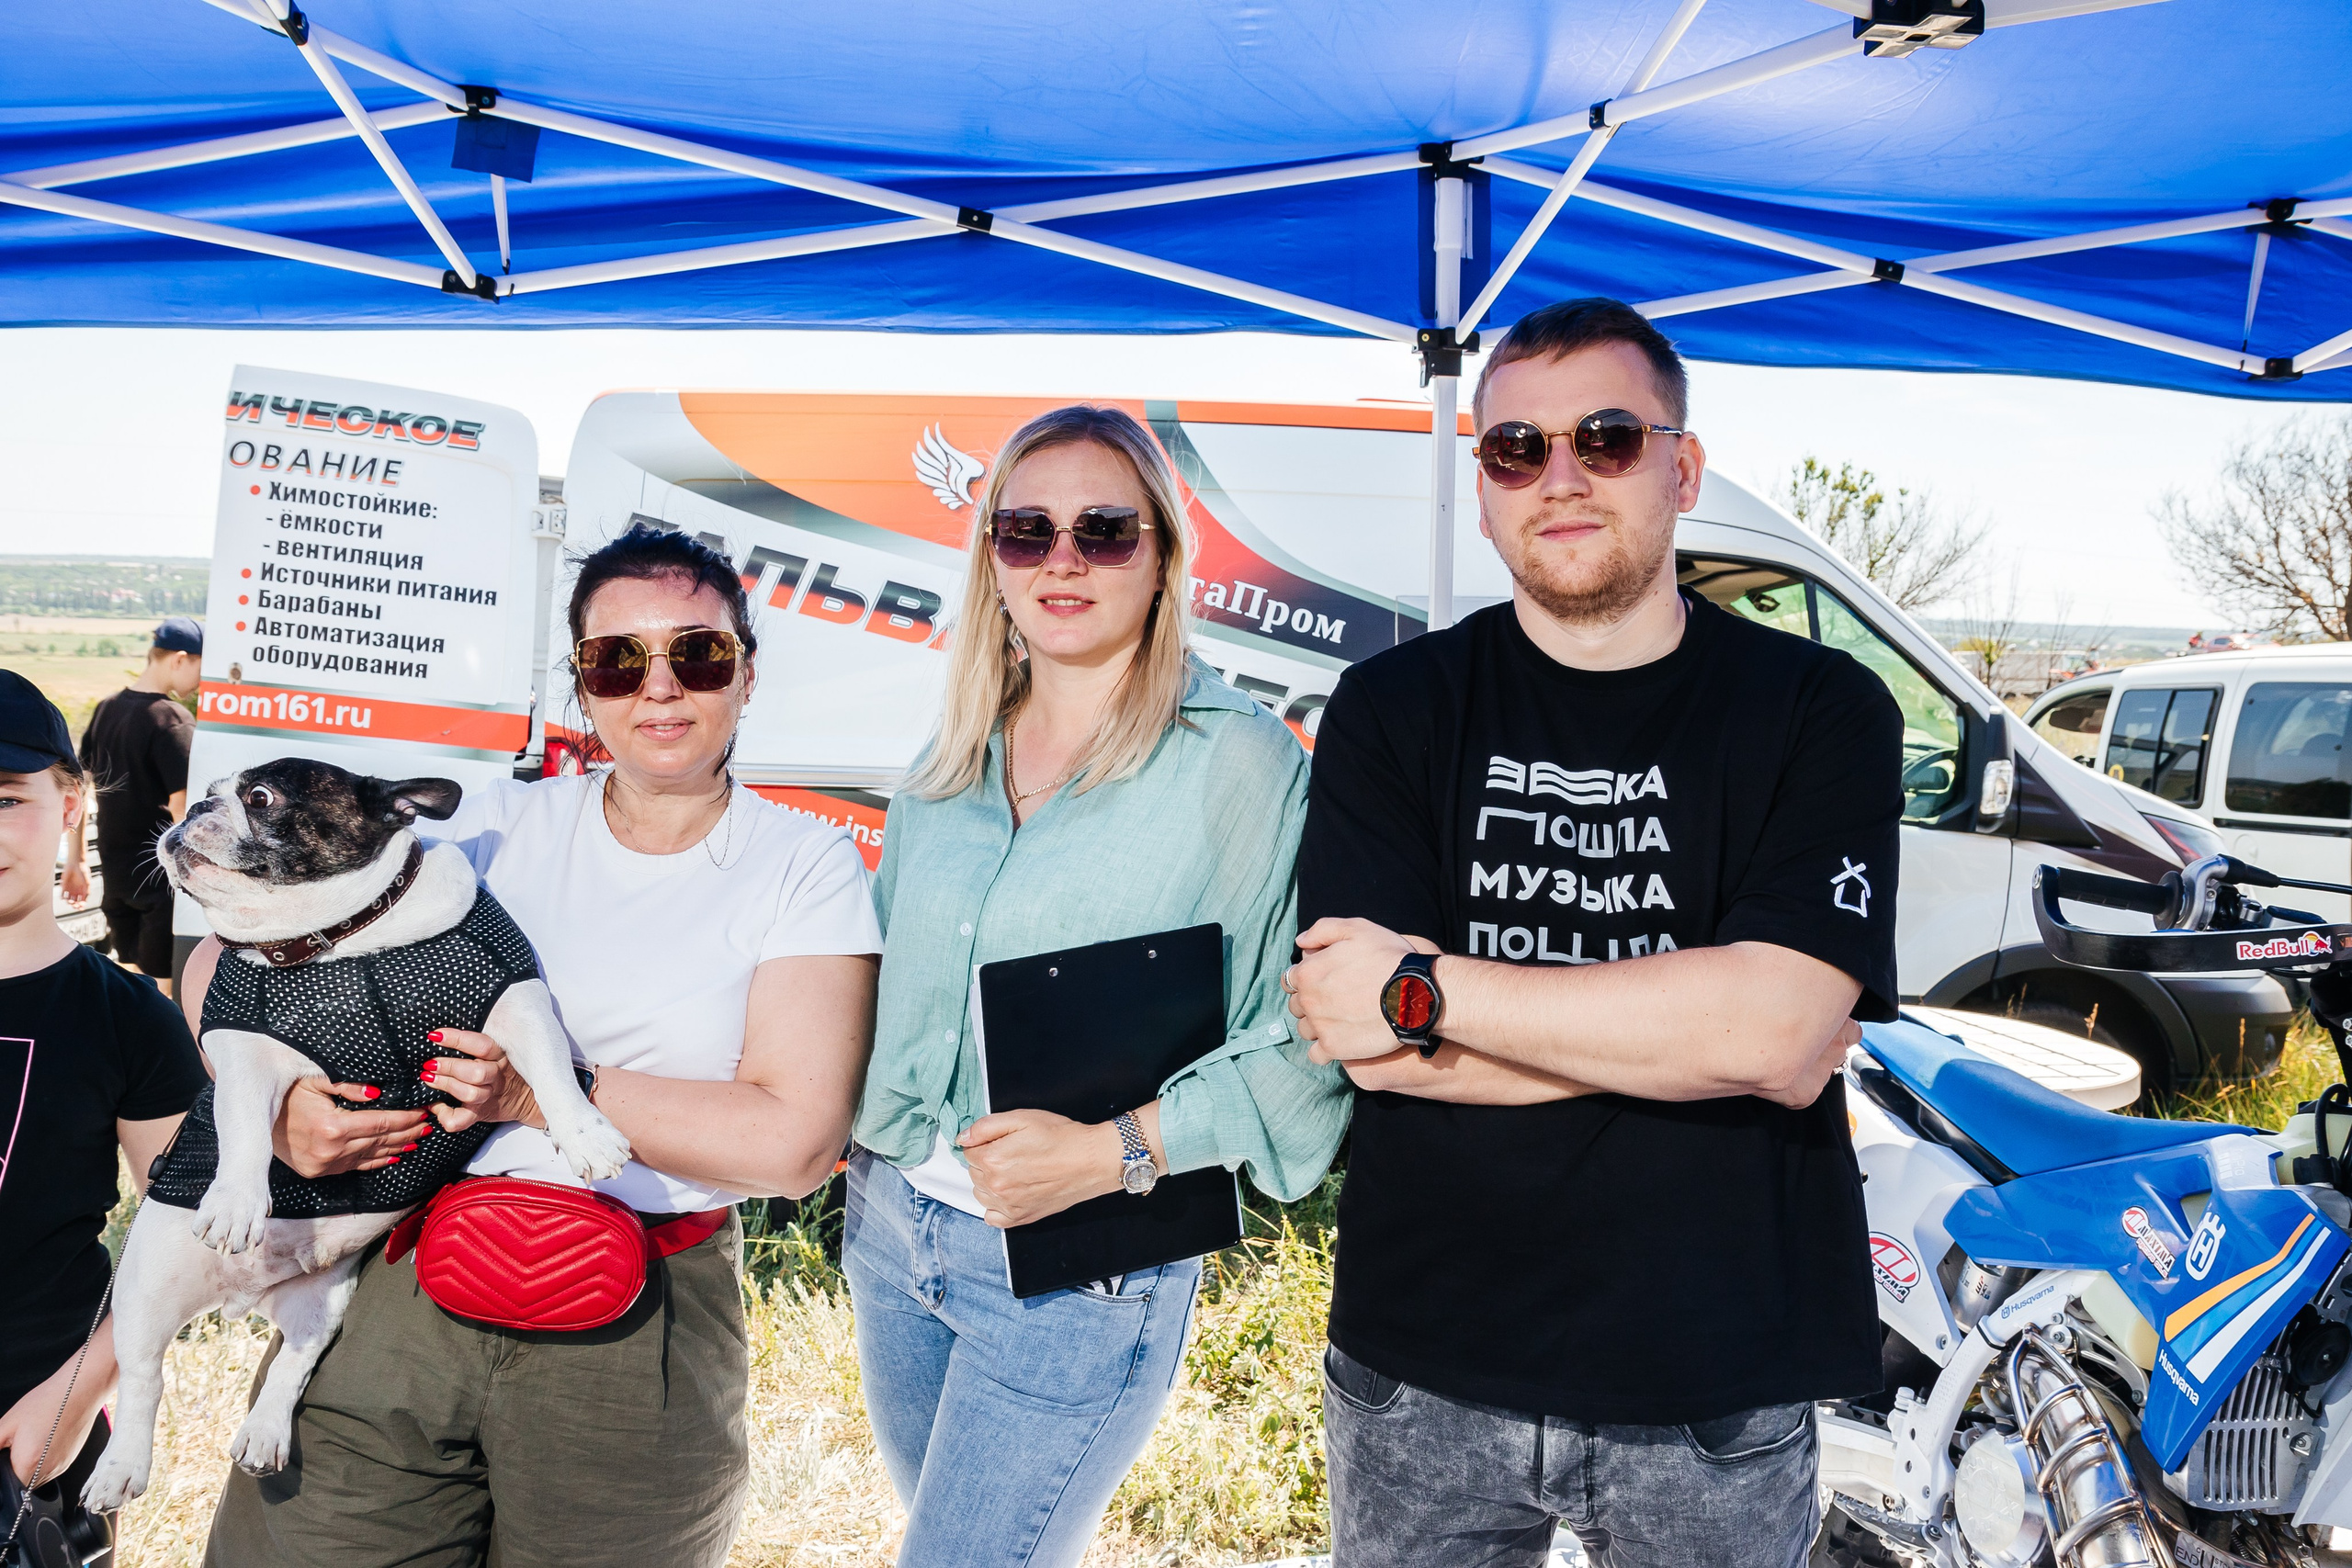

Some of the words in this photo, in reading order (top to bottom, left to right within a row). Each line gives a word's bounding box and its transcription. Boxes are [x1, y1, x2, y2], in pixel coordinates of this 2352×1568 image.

[226, 390, 485, 450] ИЧЕСКОЕ
[228, 440, 403, 486] ОВАНИЕ
[268, 481, 438, 519] Химостойкие:
[279, 509, 383, 539] ёмкости
[277, 539, 424, 570] вентиляция
[260, 562, 390, 595] Источники
[397, 580, 497, 606] питания
[257, 590, 381, 620] Барабаны
[254, 616, 445, 655] Автоматизация
[252, 645, 428, 680] оборудования
[198, 691, 372, 729] rom161.ru
[1476, 807, 1671, 859] ПОШЛА
[1470, 861, 1676, 914] МУЗЫКА
[2011, 1285, 2054, 1313] Husqvarna
[2158, 1348, 2199, 1406] Husqvarna
